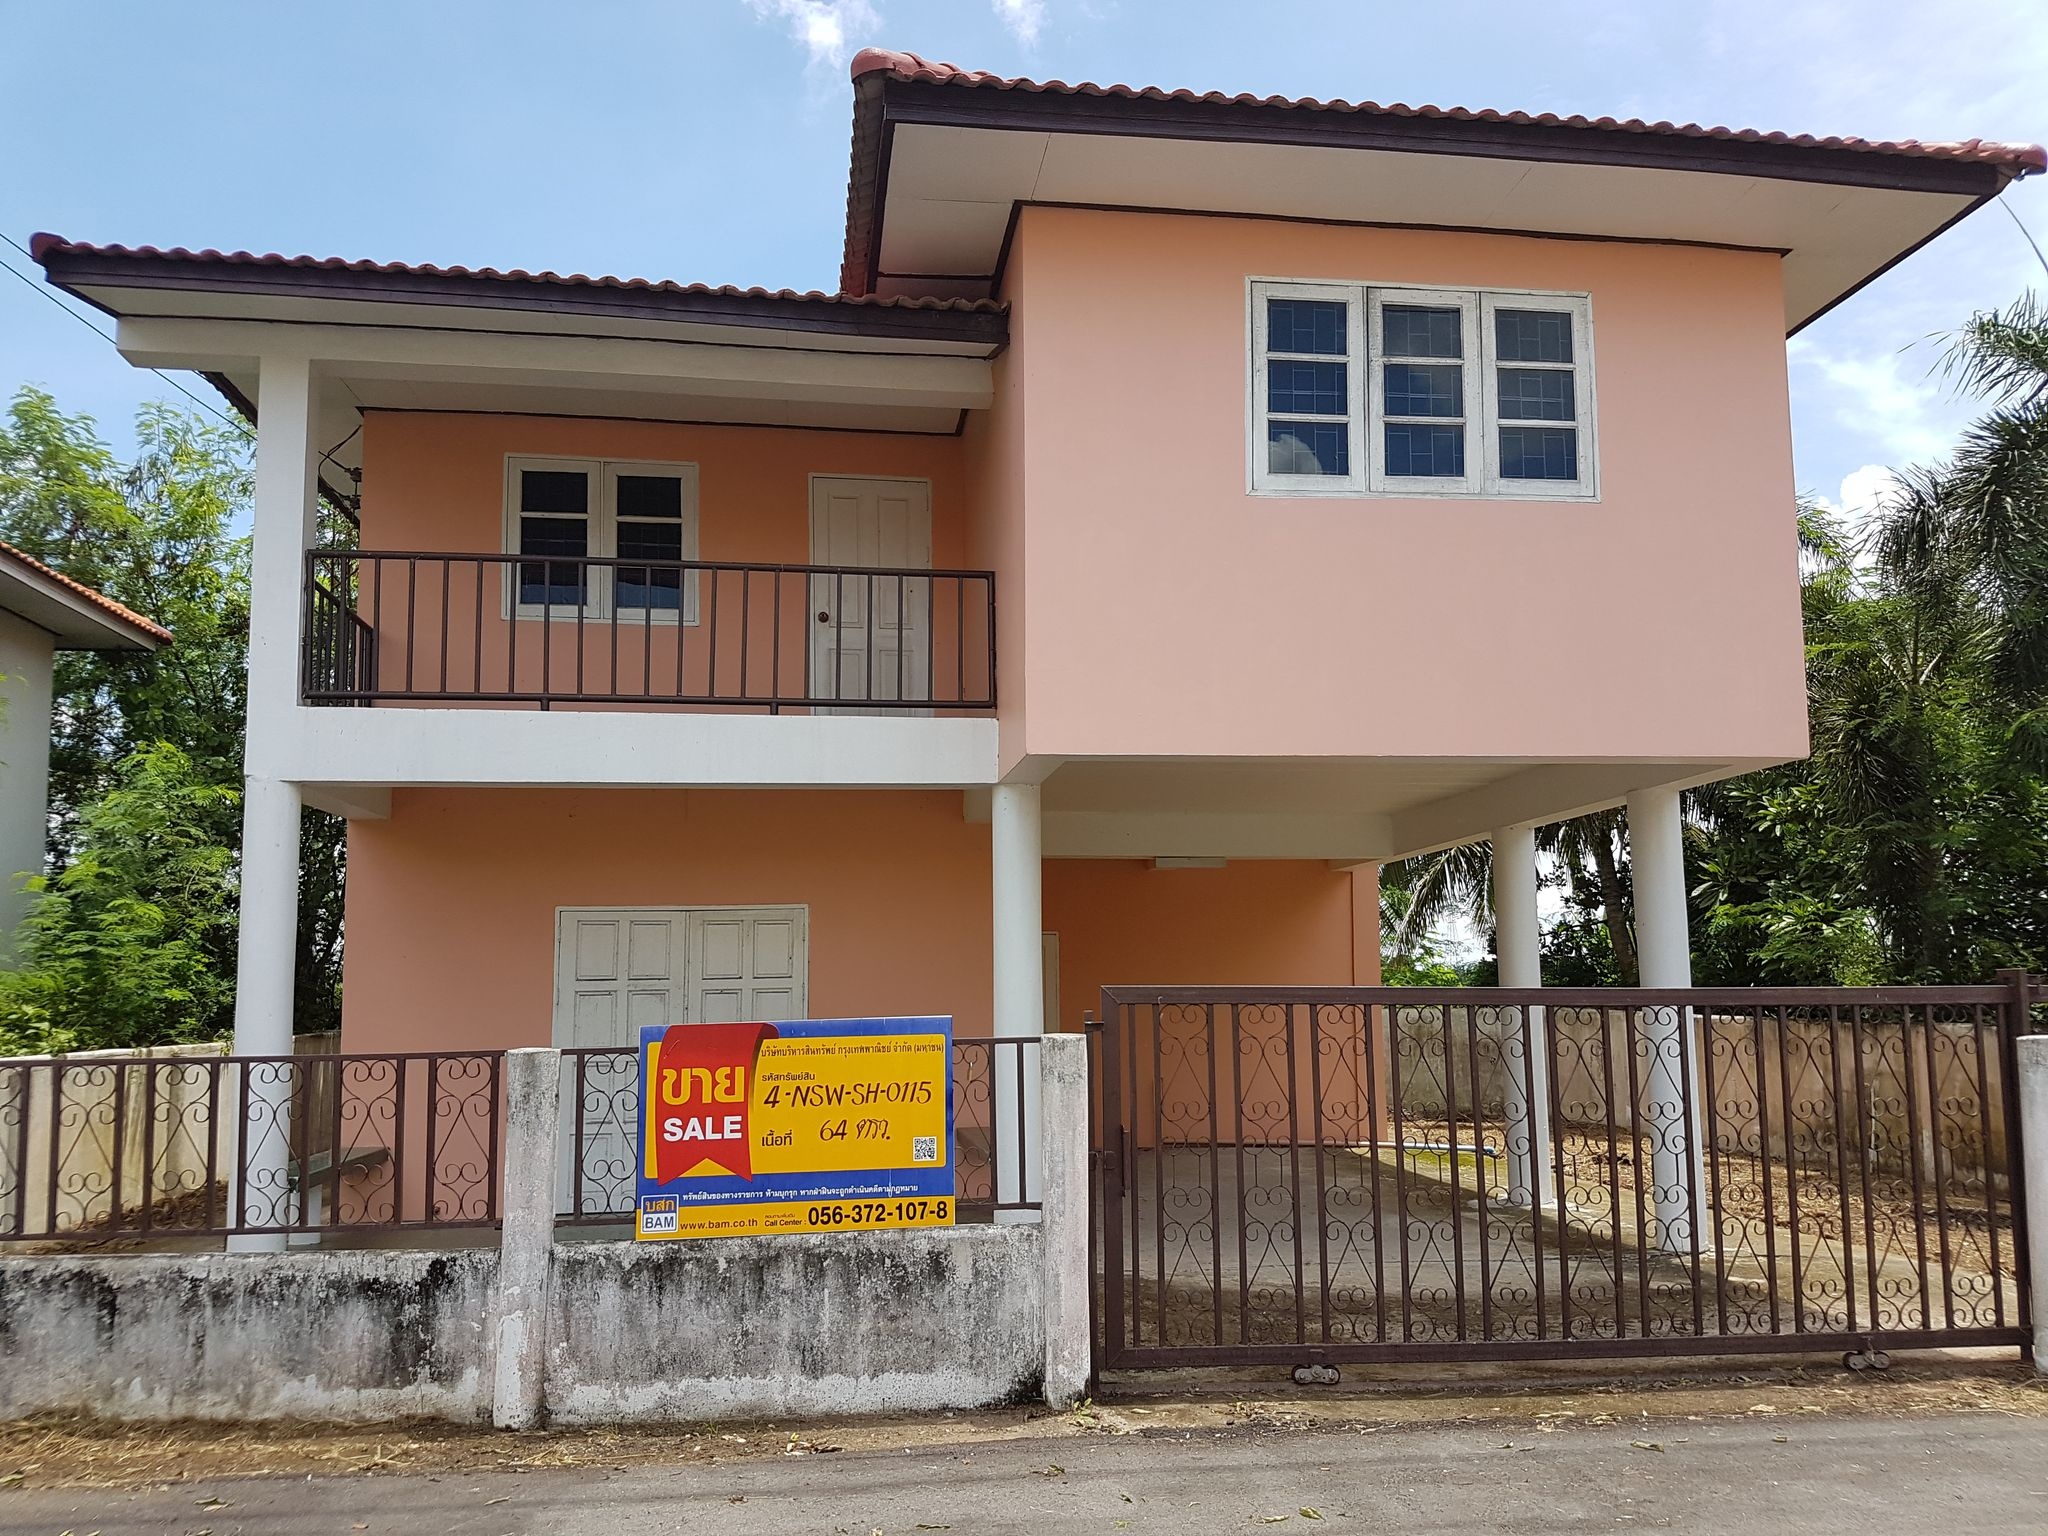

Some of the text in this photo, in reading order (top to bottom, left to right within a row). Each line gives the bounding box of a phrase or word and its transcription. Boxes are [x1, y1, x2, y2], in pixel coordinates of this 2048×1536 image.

[893, 1042, 913, 1053] จำกัด
[662, 1066, 745, 1105] ขาย
[761, 1071, 816, 1082] รหัสทรัพย์สิน
[663, 1115, 743, 1142] SALE
[819, 1119, 848, 1141] 64
[761, 1129, 793, 1147] เนื้อที่
[645, 1216, 674, 1229] BAM
[764, 1218, 778, 1227] Call
[780, 1218, 803, 1226] Center
[808, 1200, 949, 1226] 056-372-107-8
[680, 1218, 758, 1230] www.bam.co.th
